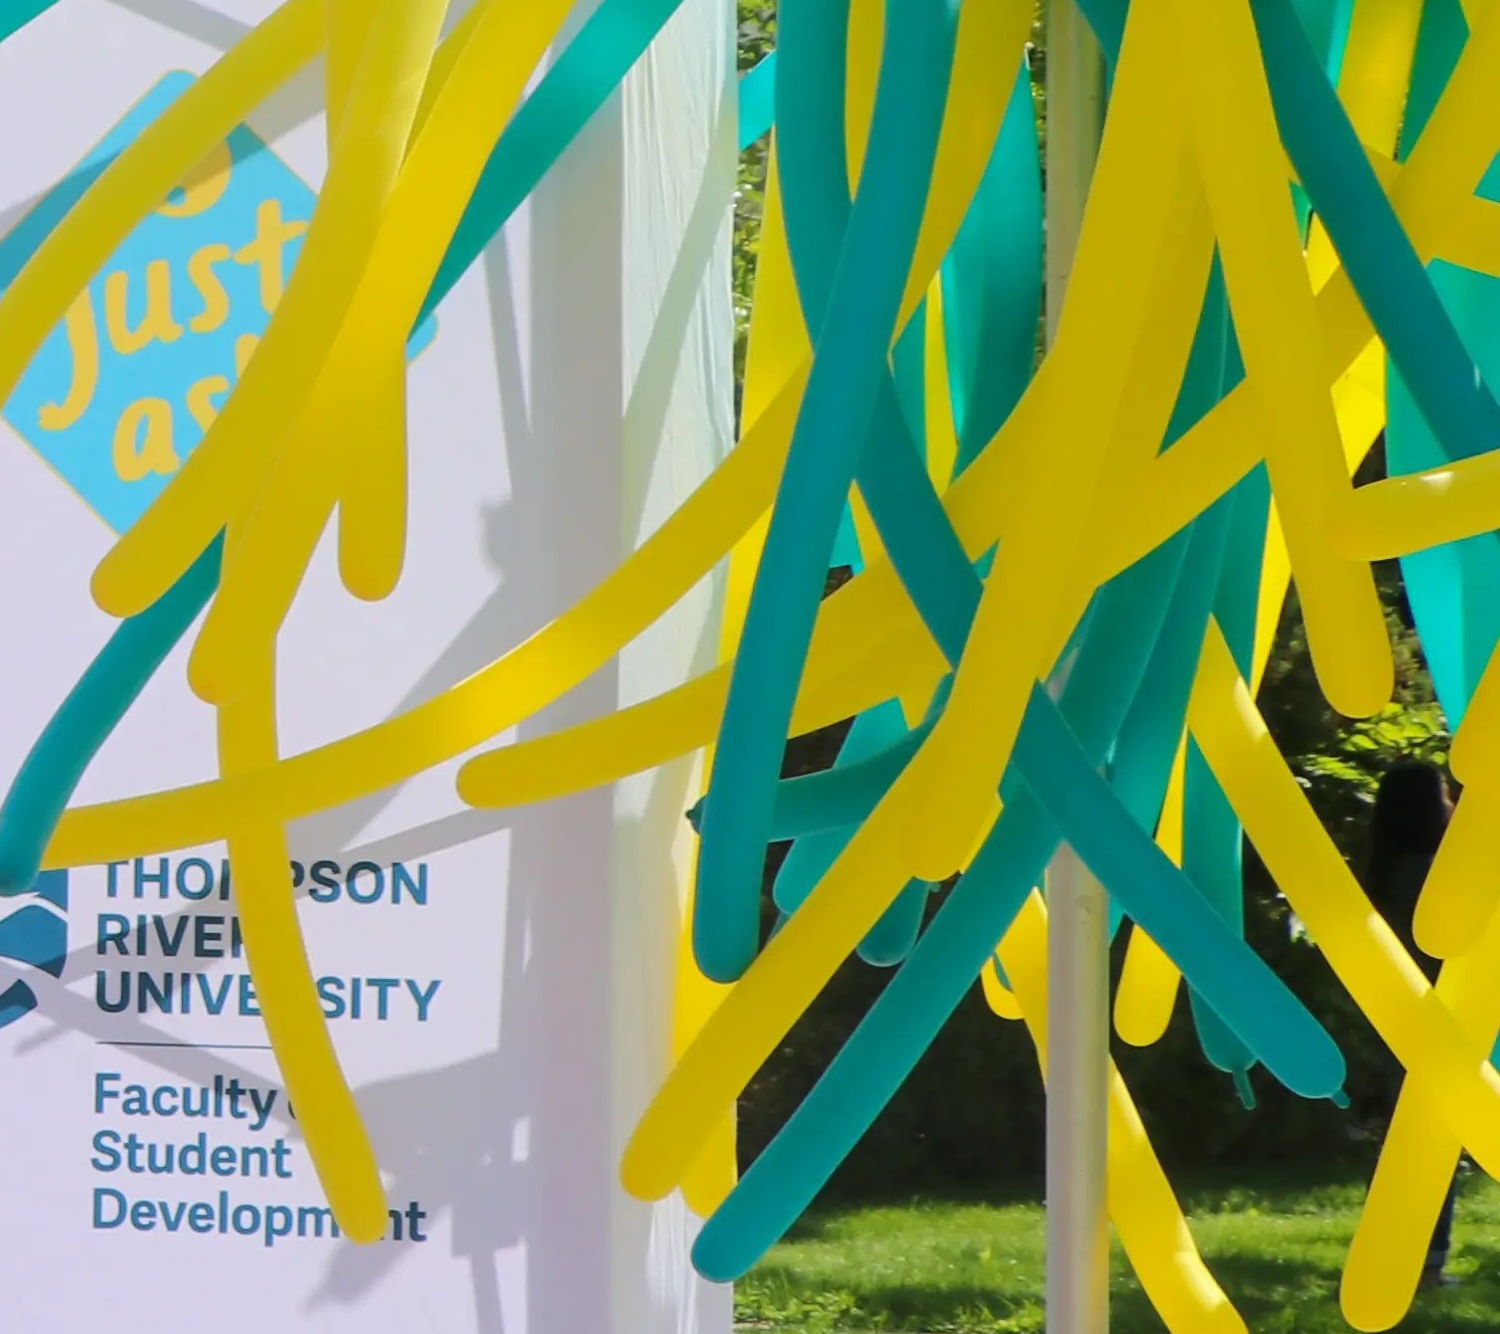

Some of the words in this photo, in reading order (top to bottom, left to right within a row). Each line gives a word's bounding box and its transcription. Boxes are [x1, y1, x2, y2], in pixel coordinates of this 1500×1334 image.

[112, 334, 260, 482] as
[104, 856, 428, 905] THOSON
[97, 914, 242, 958] RIVE
[96, 971, 442, 1021] UNIVESITY
[95, 1073, 277, 1130] Faculty
[91, 1131, 292, 1178] Student
[92, 1188, 427, 1247] Developmnt
